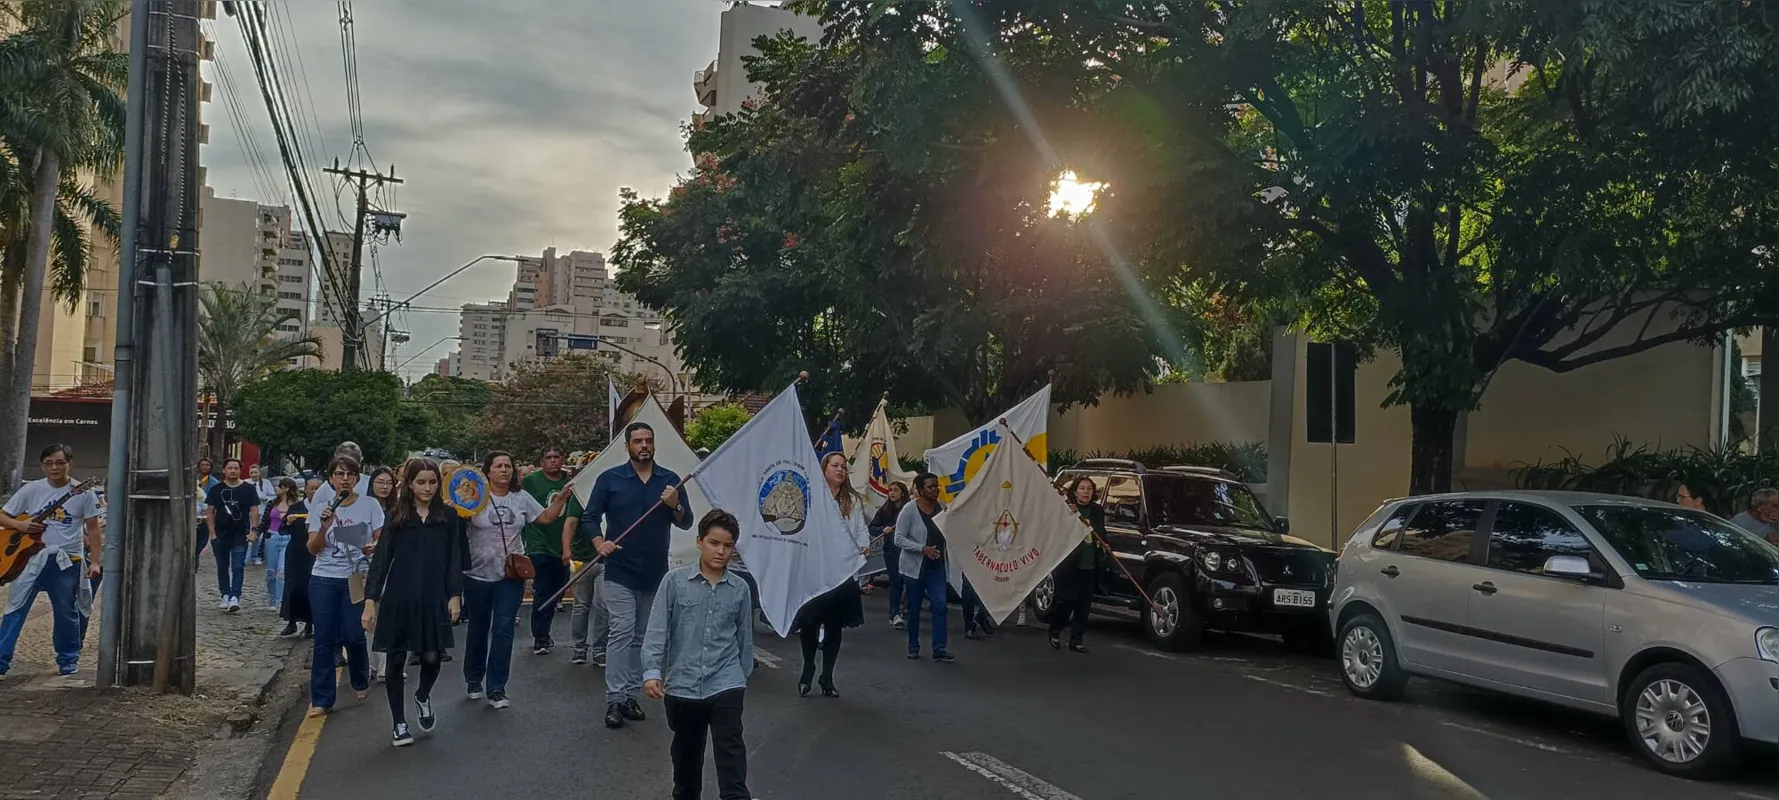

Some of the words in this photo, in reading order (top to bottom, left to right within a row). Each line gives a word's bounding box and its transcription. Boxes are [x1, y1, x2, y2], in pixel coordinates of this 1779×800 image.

[973, 545, 1019, 573] TABERNACULO
[1020, 548, 1040, 565] VIVO
[1276, 595, 1291, 604] ARS
[1293, 595, 1313, 605] 8155
